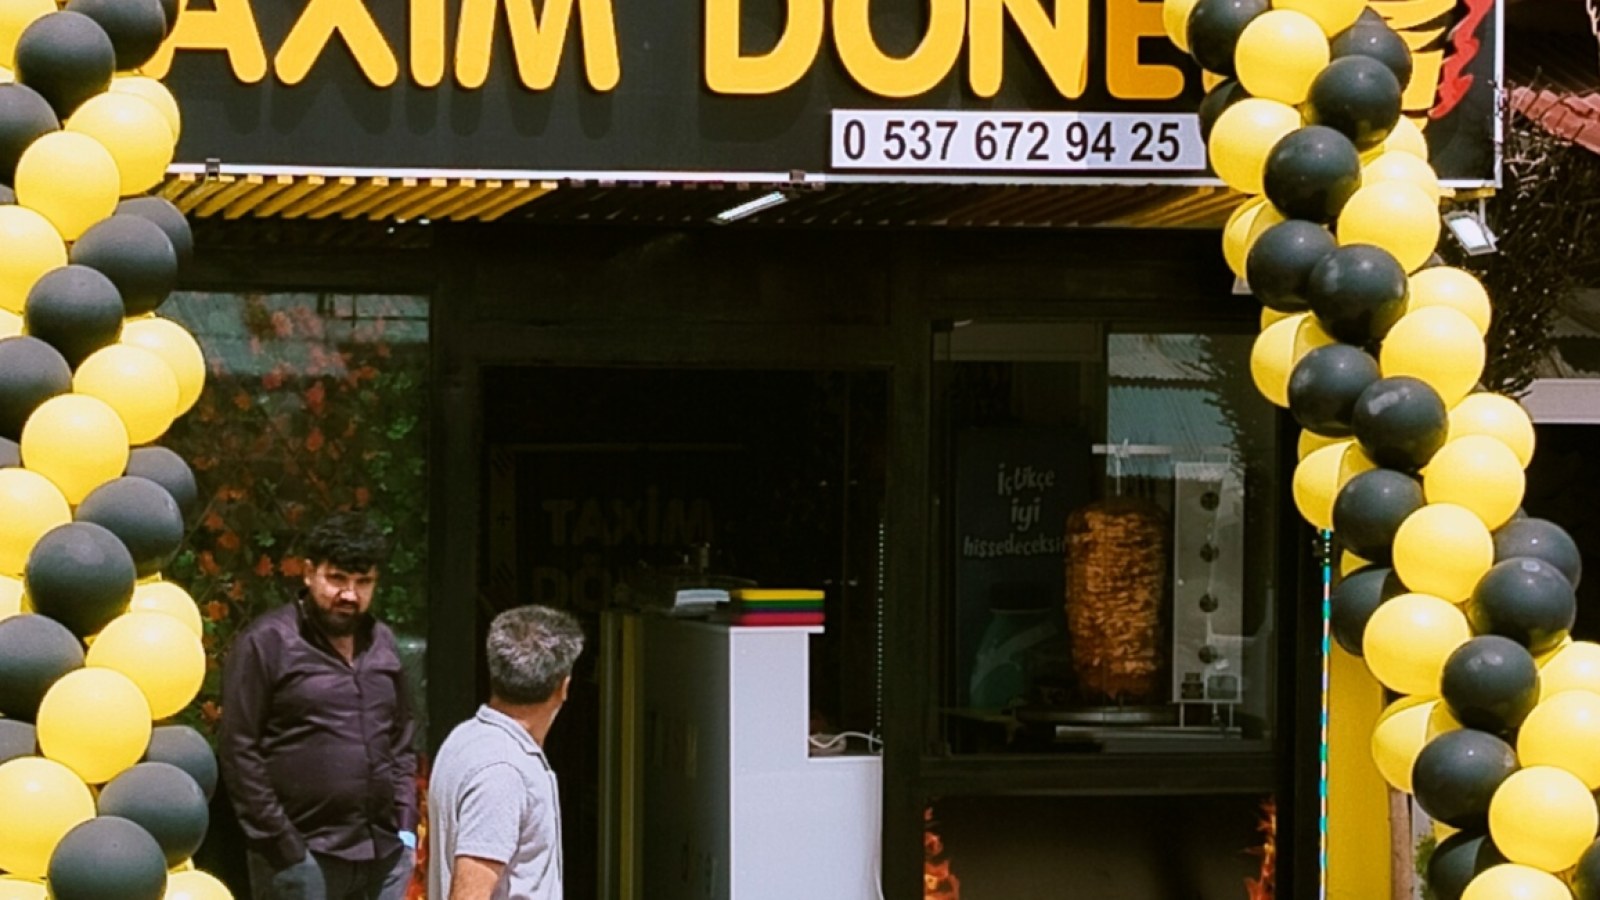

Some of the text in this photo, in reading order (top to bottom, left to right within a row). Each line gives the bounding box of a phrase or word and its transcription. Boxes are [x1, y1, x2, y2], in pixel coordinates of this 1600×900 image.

[704, 0, 1229, 99] DONE
[843, 119, 1180, 162] 0 537 672 94 25
[1010, 497, 1042, 532] iyi
